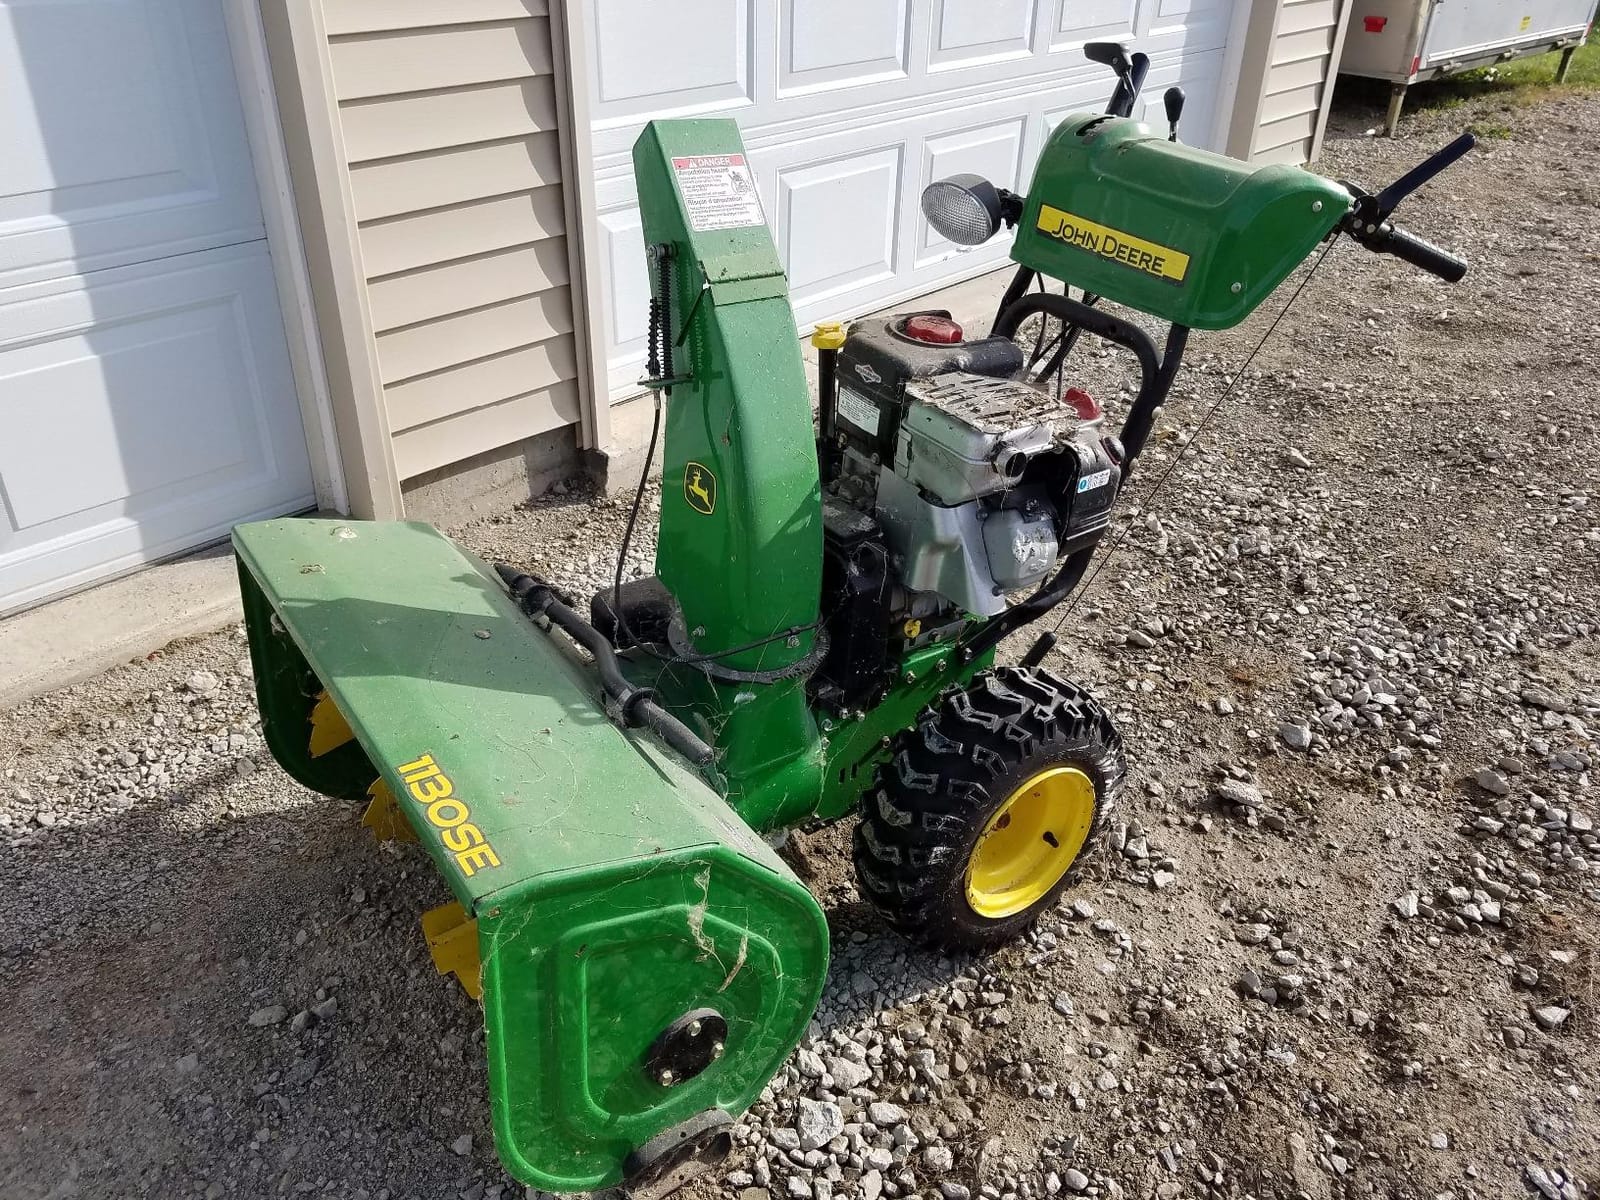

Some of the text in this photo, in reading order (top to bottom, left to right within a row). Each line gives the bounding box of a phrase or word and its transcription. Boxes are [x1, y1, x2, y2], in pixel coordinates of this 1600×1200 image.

[698, 157, 731, 167] DANGER
[1051, 218, 1166, 275] JOHN DEERE
[397, 753, 503, 878] 1130SE
